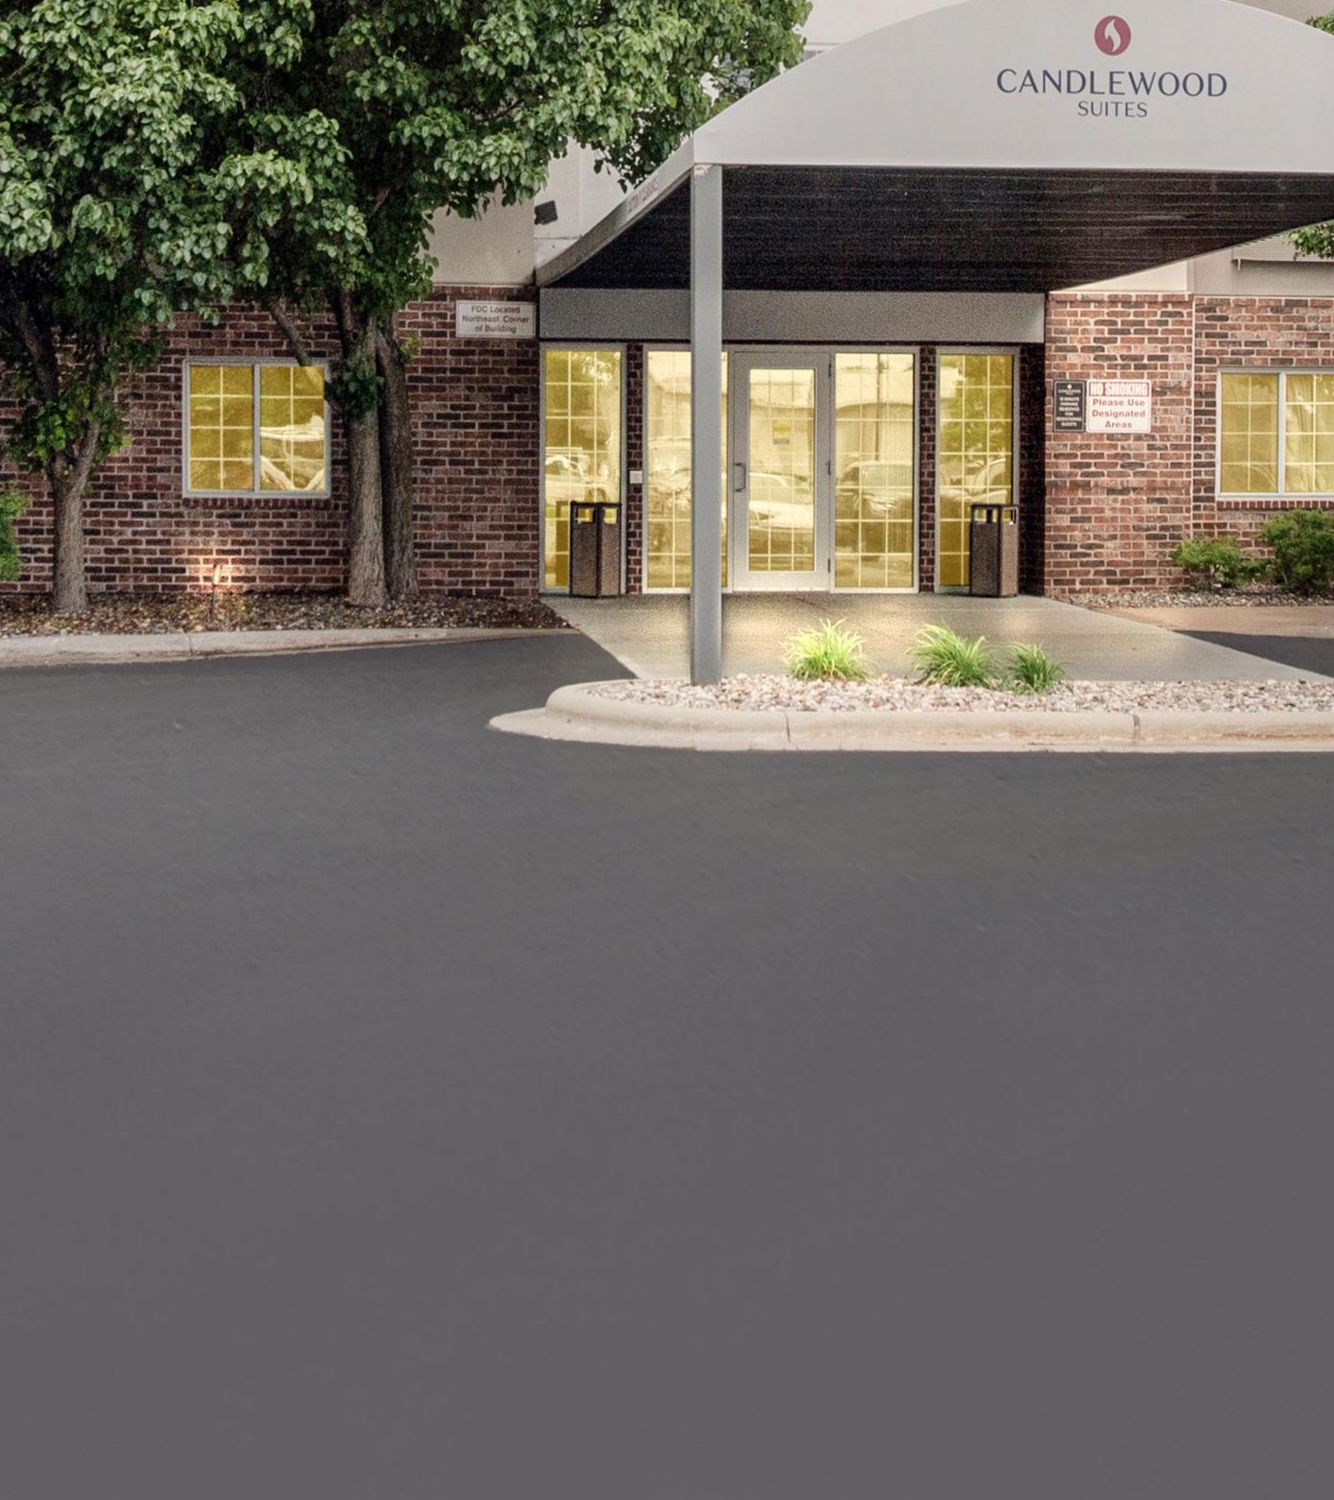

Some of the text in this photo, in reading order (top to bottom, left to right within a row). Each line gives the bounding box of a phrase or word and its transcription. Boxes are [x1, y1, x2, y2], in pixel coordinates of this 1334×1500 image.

[996, 68, 1228, 97] CANDLEWOOD
[1077, 100, 1148, 118] SUITES
[490, 305, 521, 314] Located
[462, 314, 529, 324] Northeast Corner
[475, 324, 517, 334] of Building
[1091, 383, 1148, 396] NO SMOKING
[1092, 398, 1146, 406] Please Use
[1091, 409, 1146, 419] Designated
[1105, 420, 1132, 428] Areas
